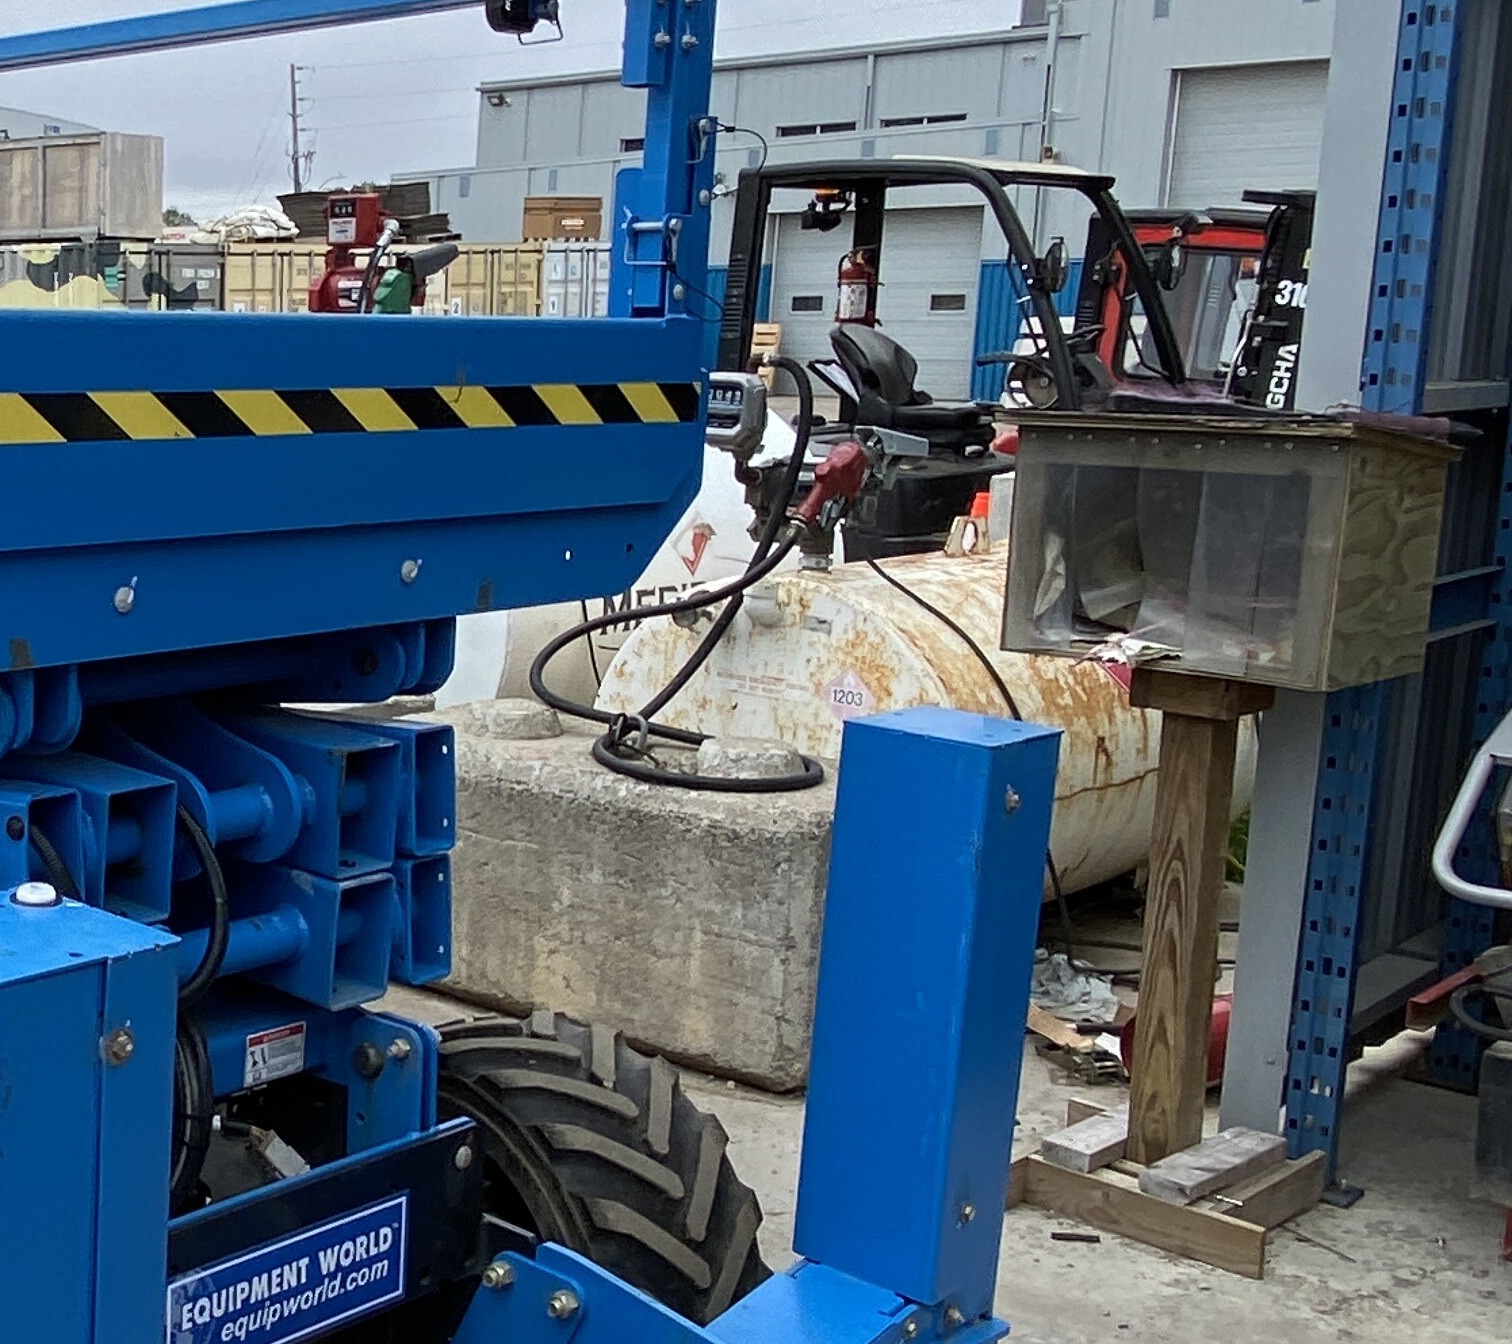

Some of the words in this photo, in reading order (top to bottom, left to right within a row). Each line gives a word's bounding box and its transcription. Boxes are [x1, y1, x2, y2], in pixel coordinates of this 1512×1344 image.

[832, 688, 864, 708] 1203
[180, 1256, 311, 1332] EQUIPMENT
[317, 1227, 395, 1276] WORLD
[221, 1258, 390, 1343] equipworld.com
